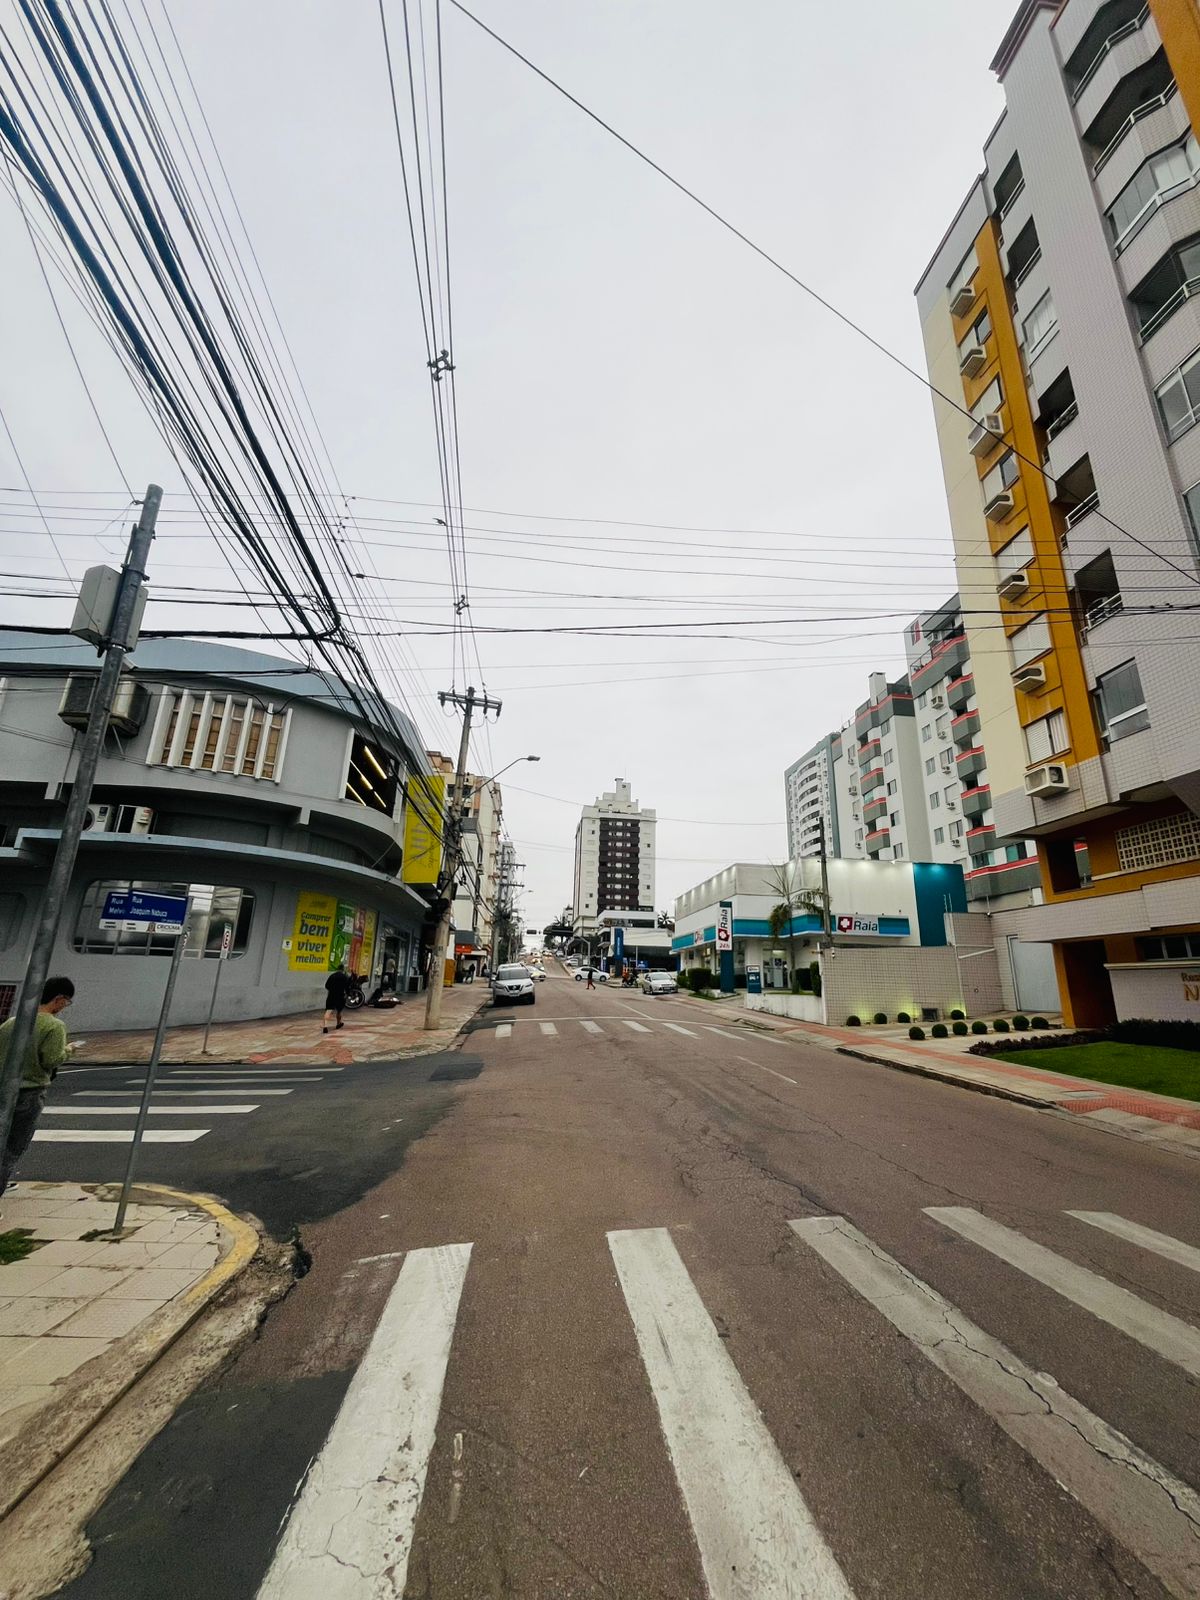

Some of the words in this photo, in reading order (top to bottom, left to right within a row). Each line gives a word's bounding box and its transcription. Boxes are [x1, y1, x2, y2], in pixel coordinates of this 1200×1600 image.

[301, 911, 331, 923] Comprar
[720, 908, 728, 929] Raia
[299, 919, 329, 938] bem
[853, 920, 878, 931] Raia
[297, 939, 327, 953] viver
[295, 953, 325, 964] melhor
